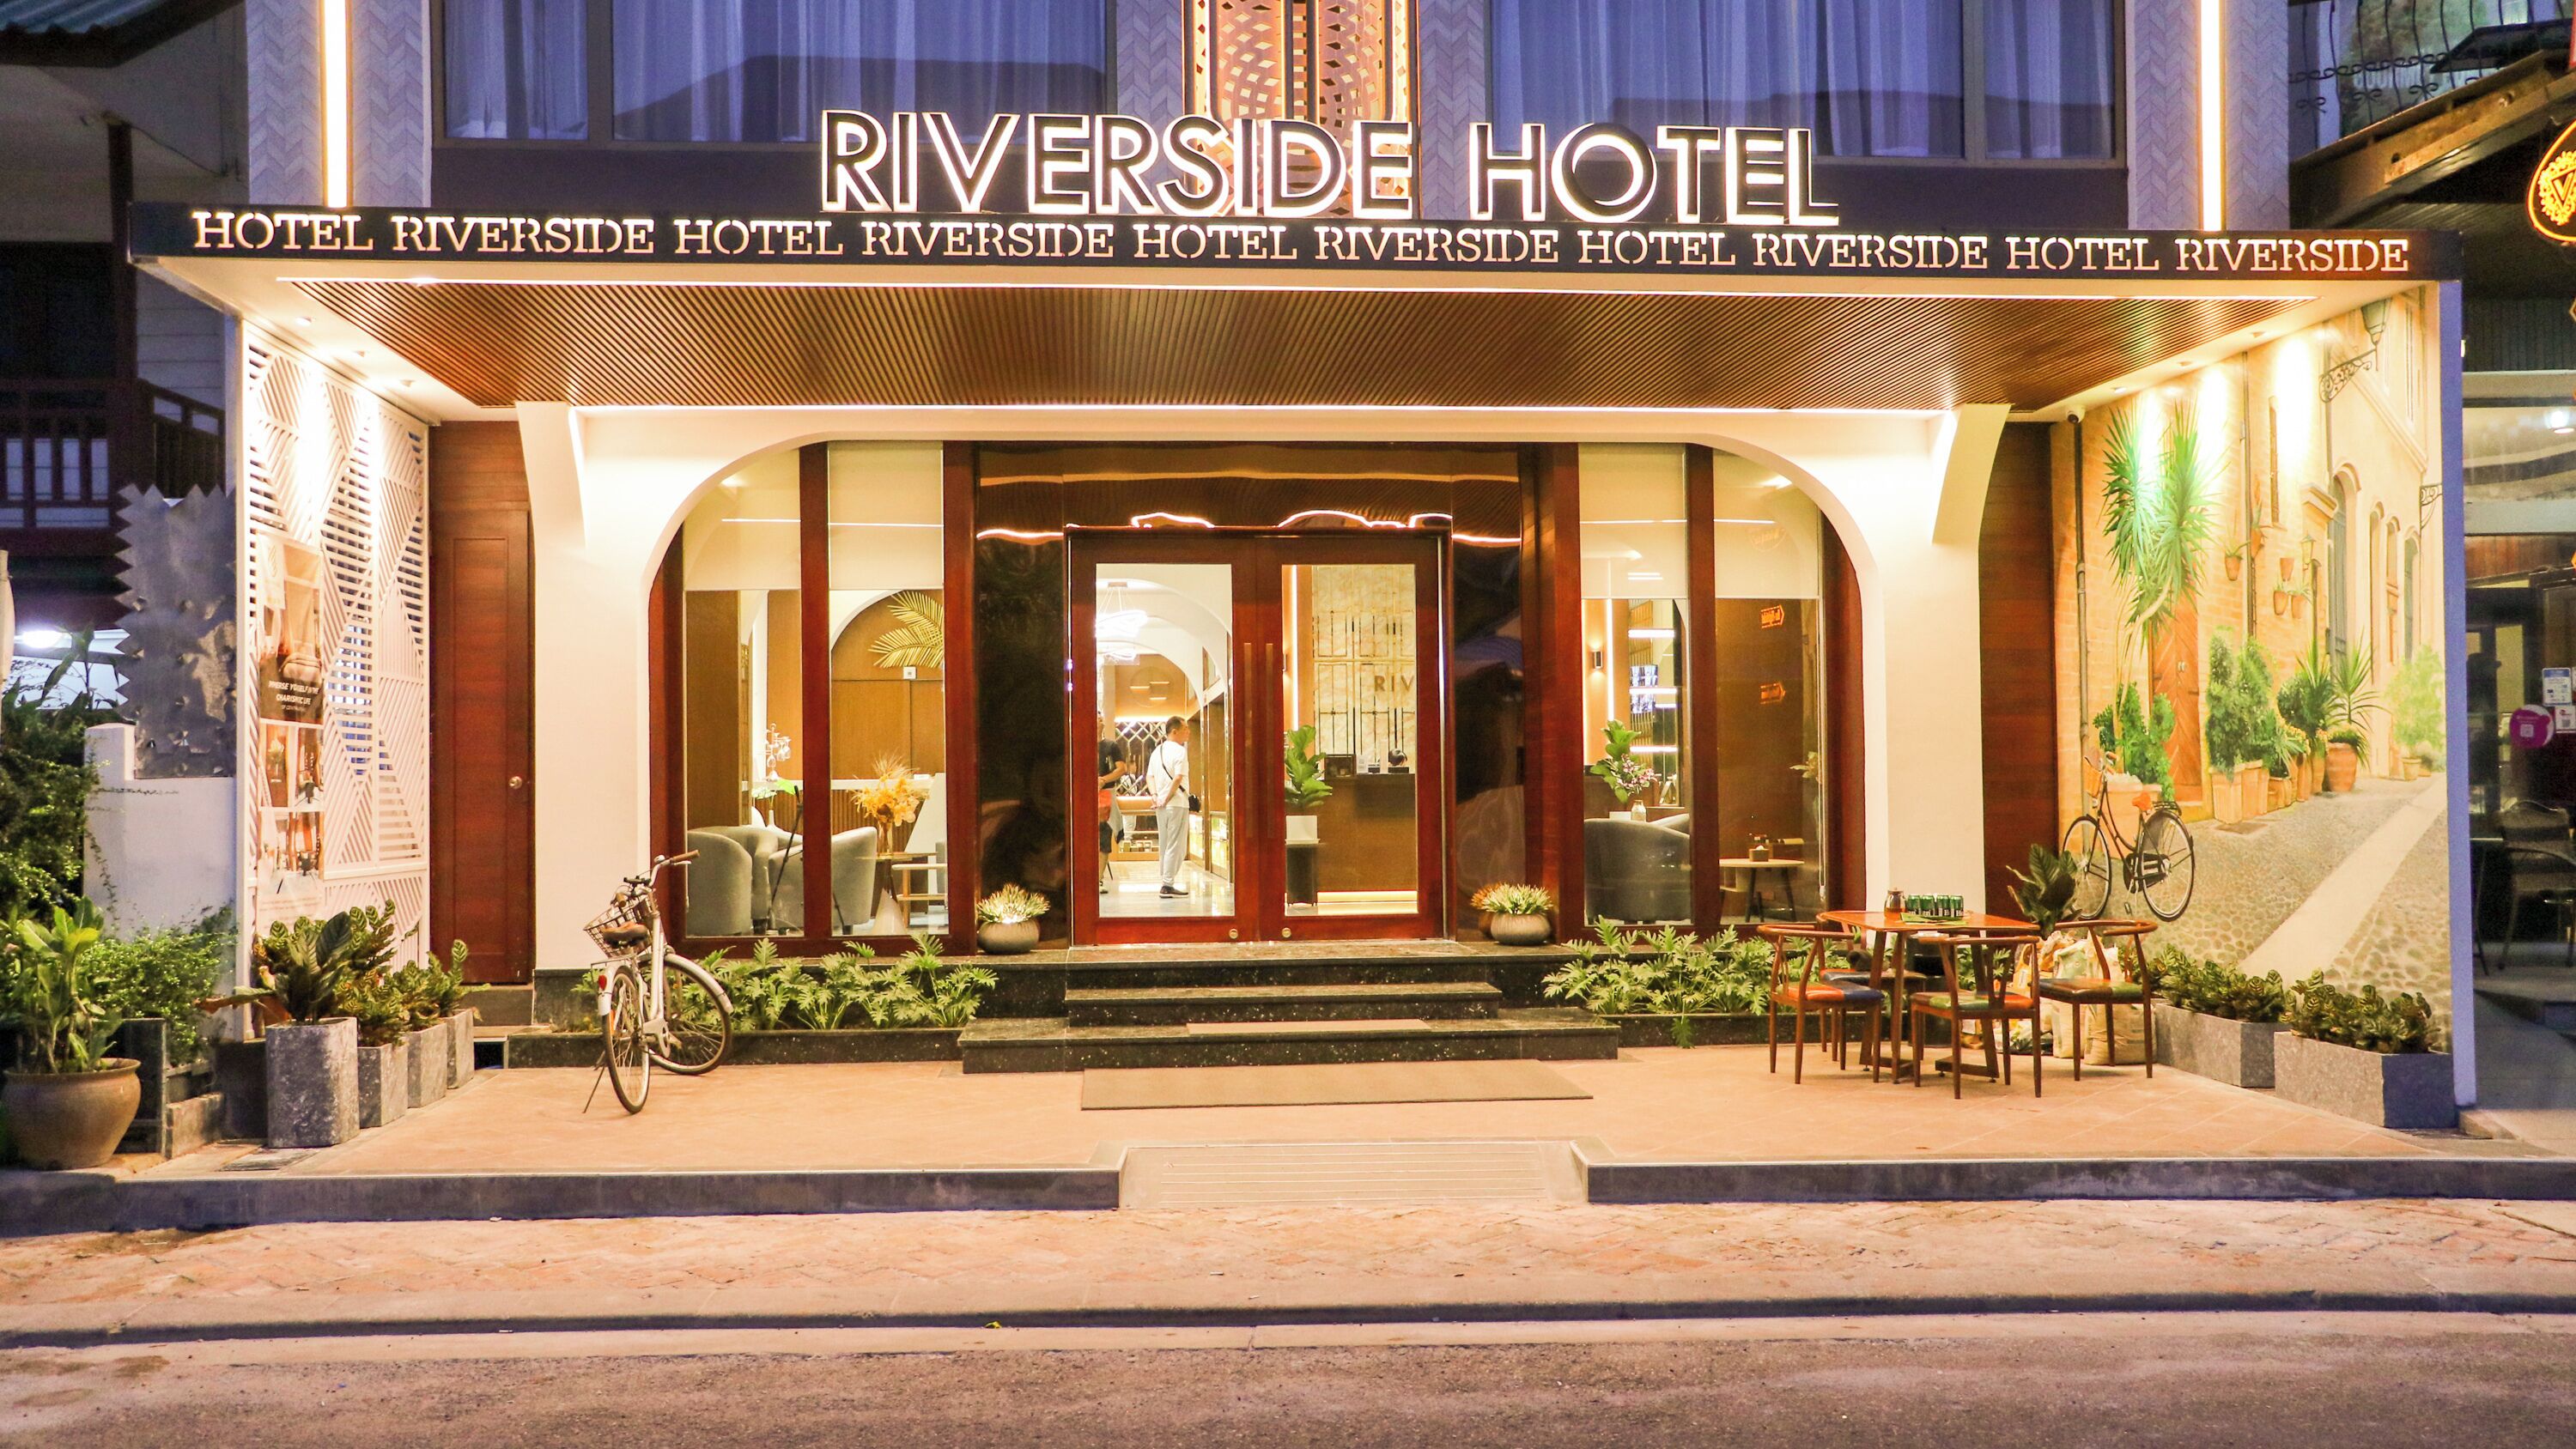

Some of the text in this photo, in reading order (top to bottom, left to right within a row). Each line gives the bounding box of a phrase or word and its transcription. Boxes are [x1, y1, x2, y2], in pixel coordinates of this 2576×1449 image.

[820, 109, 1839, 226] RIVERSIDE HOTEL
[191, 211, 2409, 272] HOTEL RIVERSIDE HOTEL RIVERSIDE HOTEL RIVERSIDE HOTEL RIVERSIDE HOTEL RIVERSIDE
